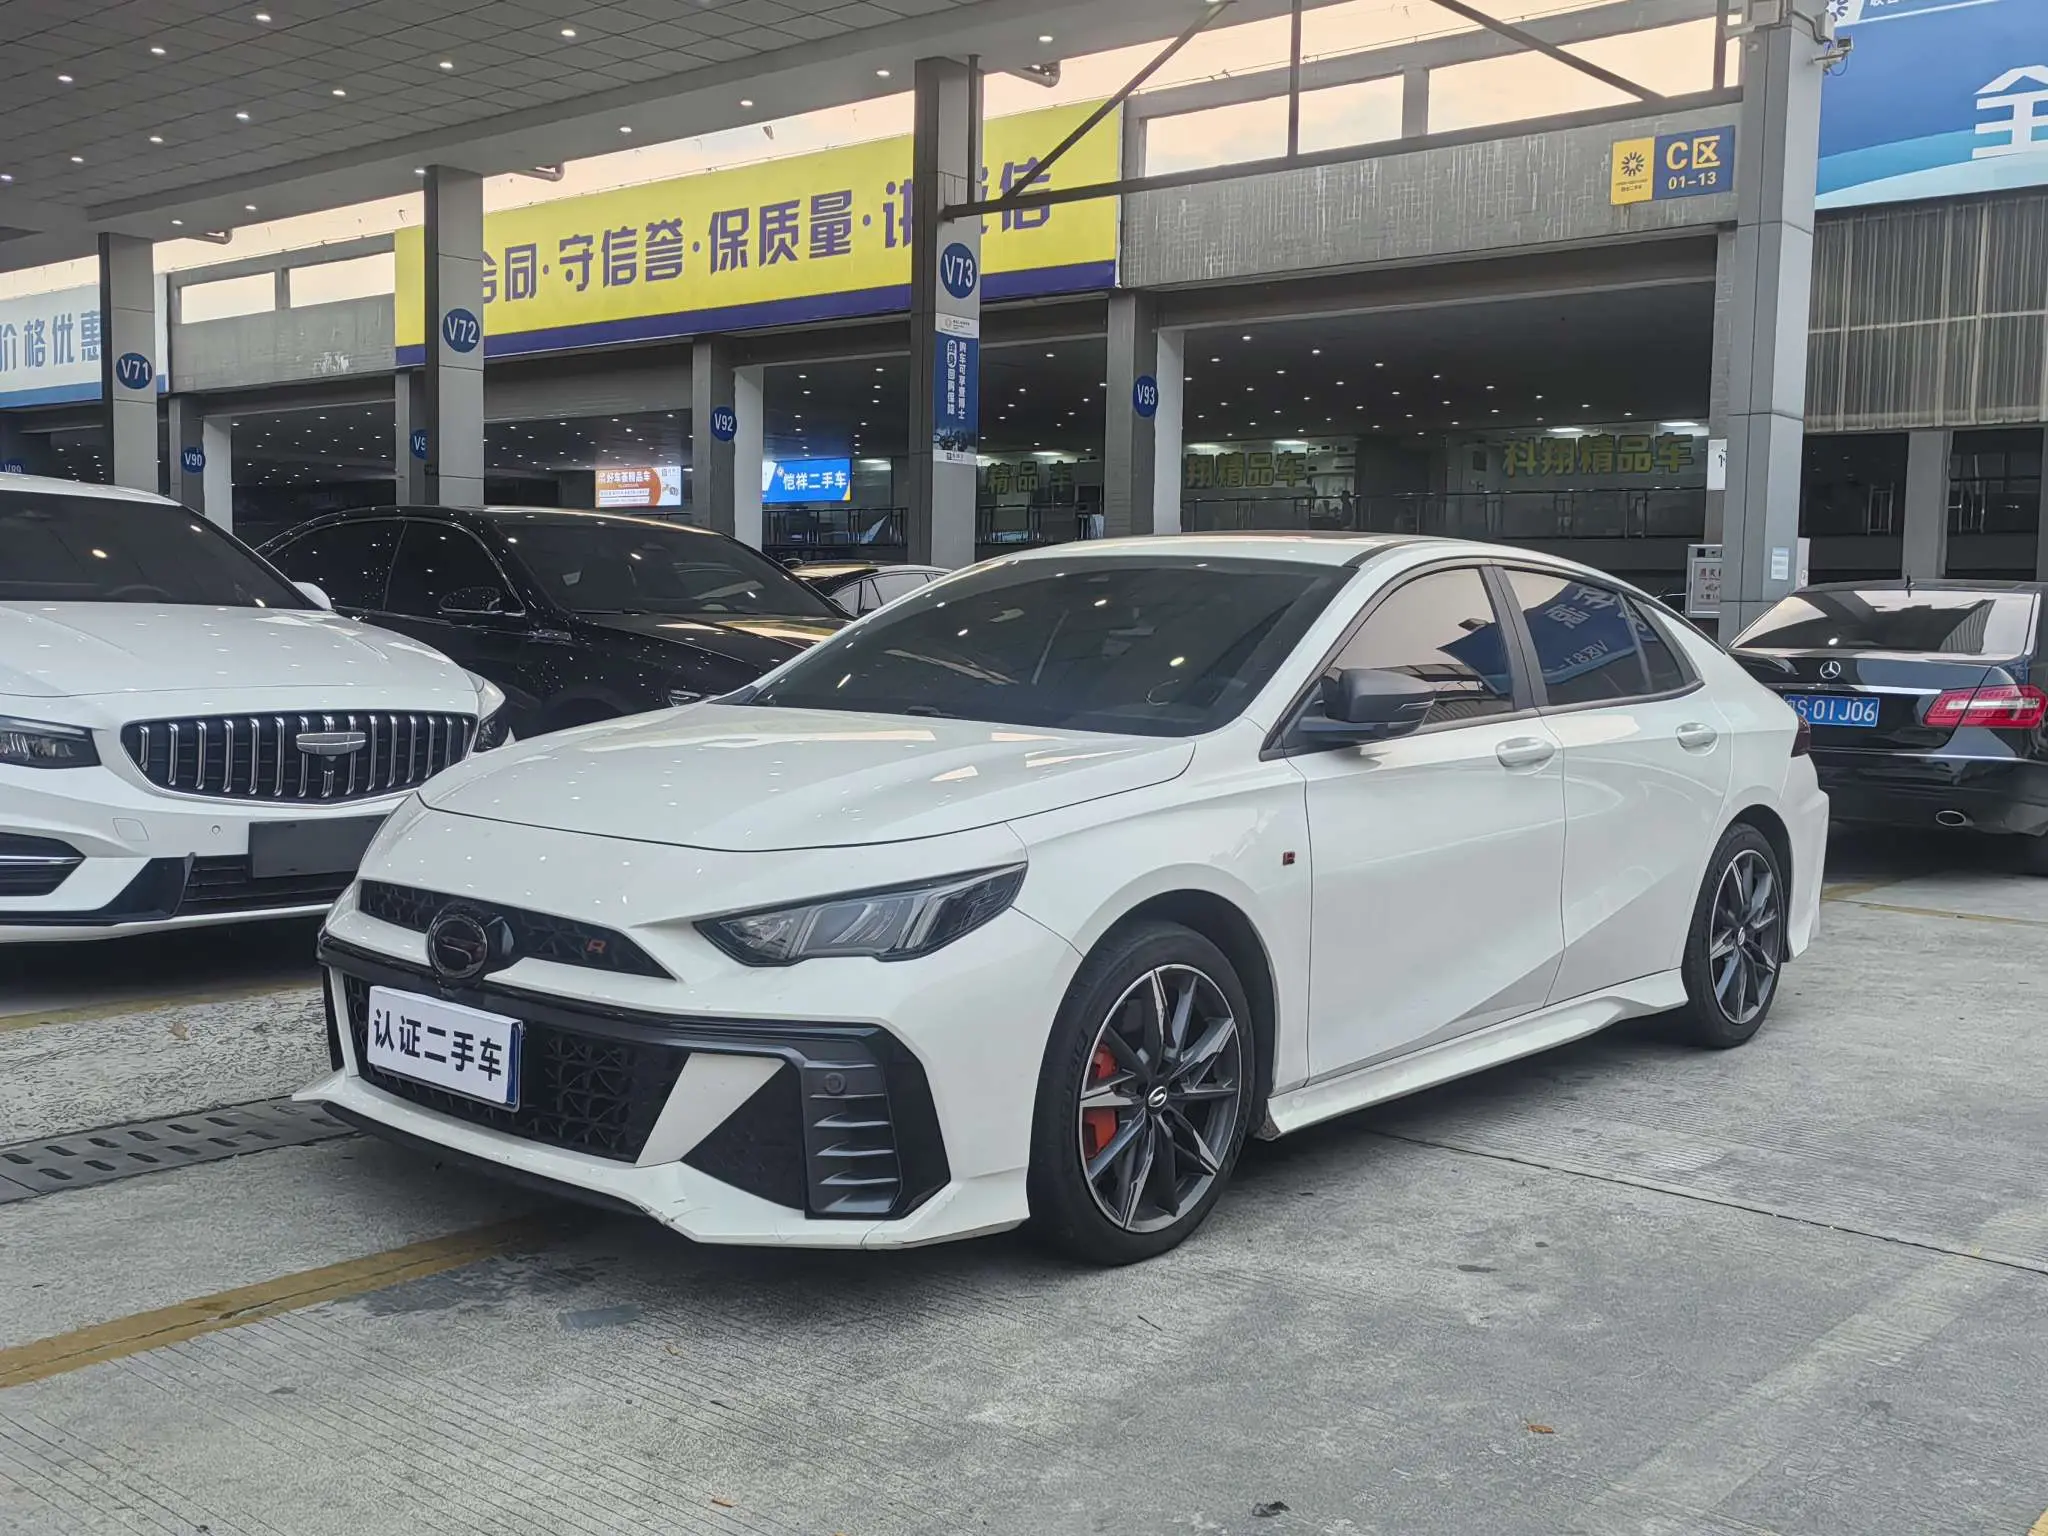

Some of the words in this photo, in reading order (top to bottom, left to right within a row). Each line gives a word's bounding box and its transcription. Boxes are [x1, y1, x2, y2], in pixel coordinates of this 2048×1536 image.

[1666, 135, 1721, 170] C区
[1668, 171, 1717, 190] 01-13
[944, 253, 973, 288] V73
[0, 310, 101, 372] 价格优惠
[446, 316, 477, 344] V72
[120, 358, 150, 381] V71
[1137, 383, 1155, 405] V93
[714, 412, 733, 432] V92
[413, 434, 426, 451] V9
[1502, 432, 1695, 478] 科翔精品车
[184, 451, 203, 467] V90
[373, 1008, 504, 1082] 认证二手车
